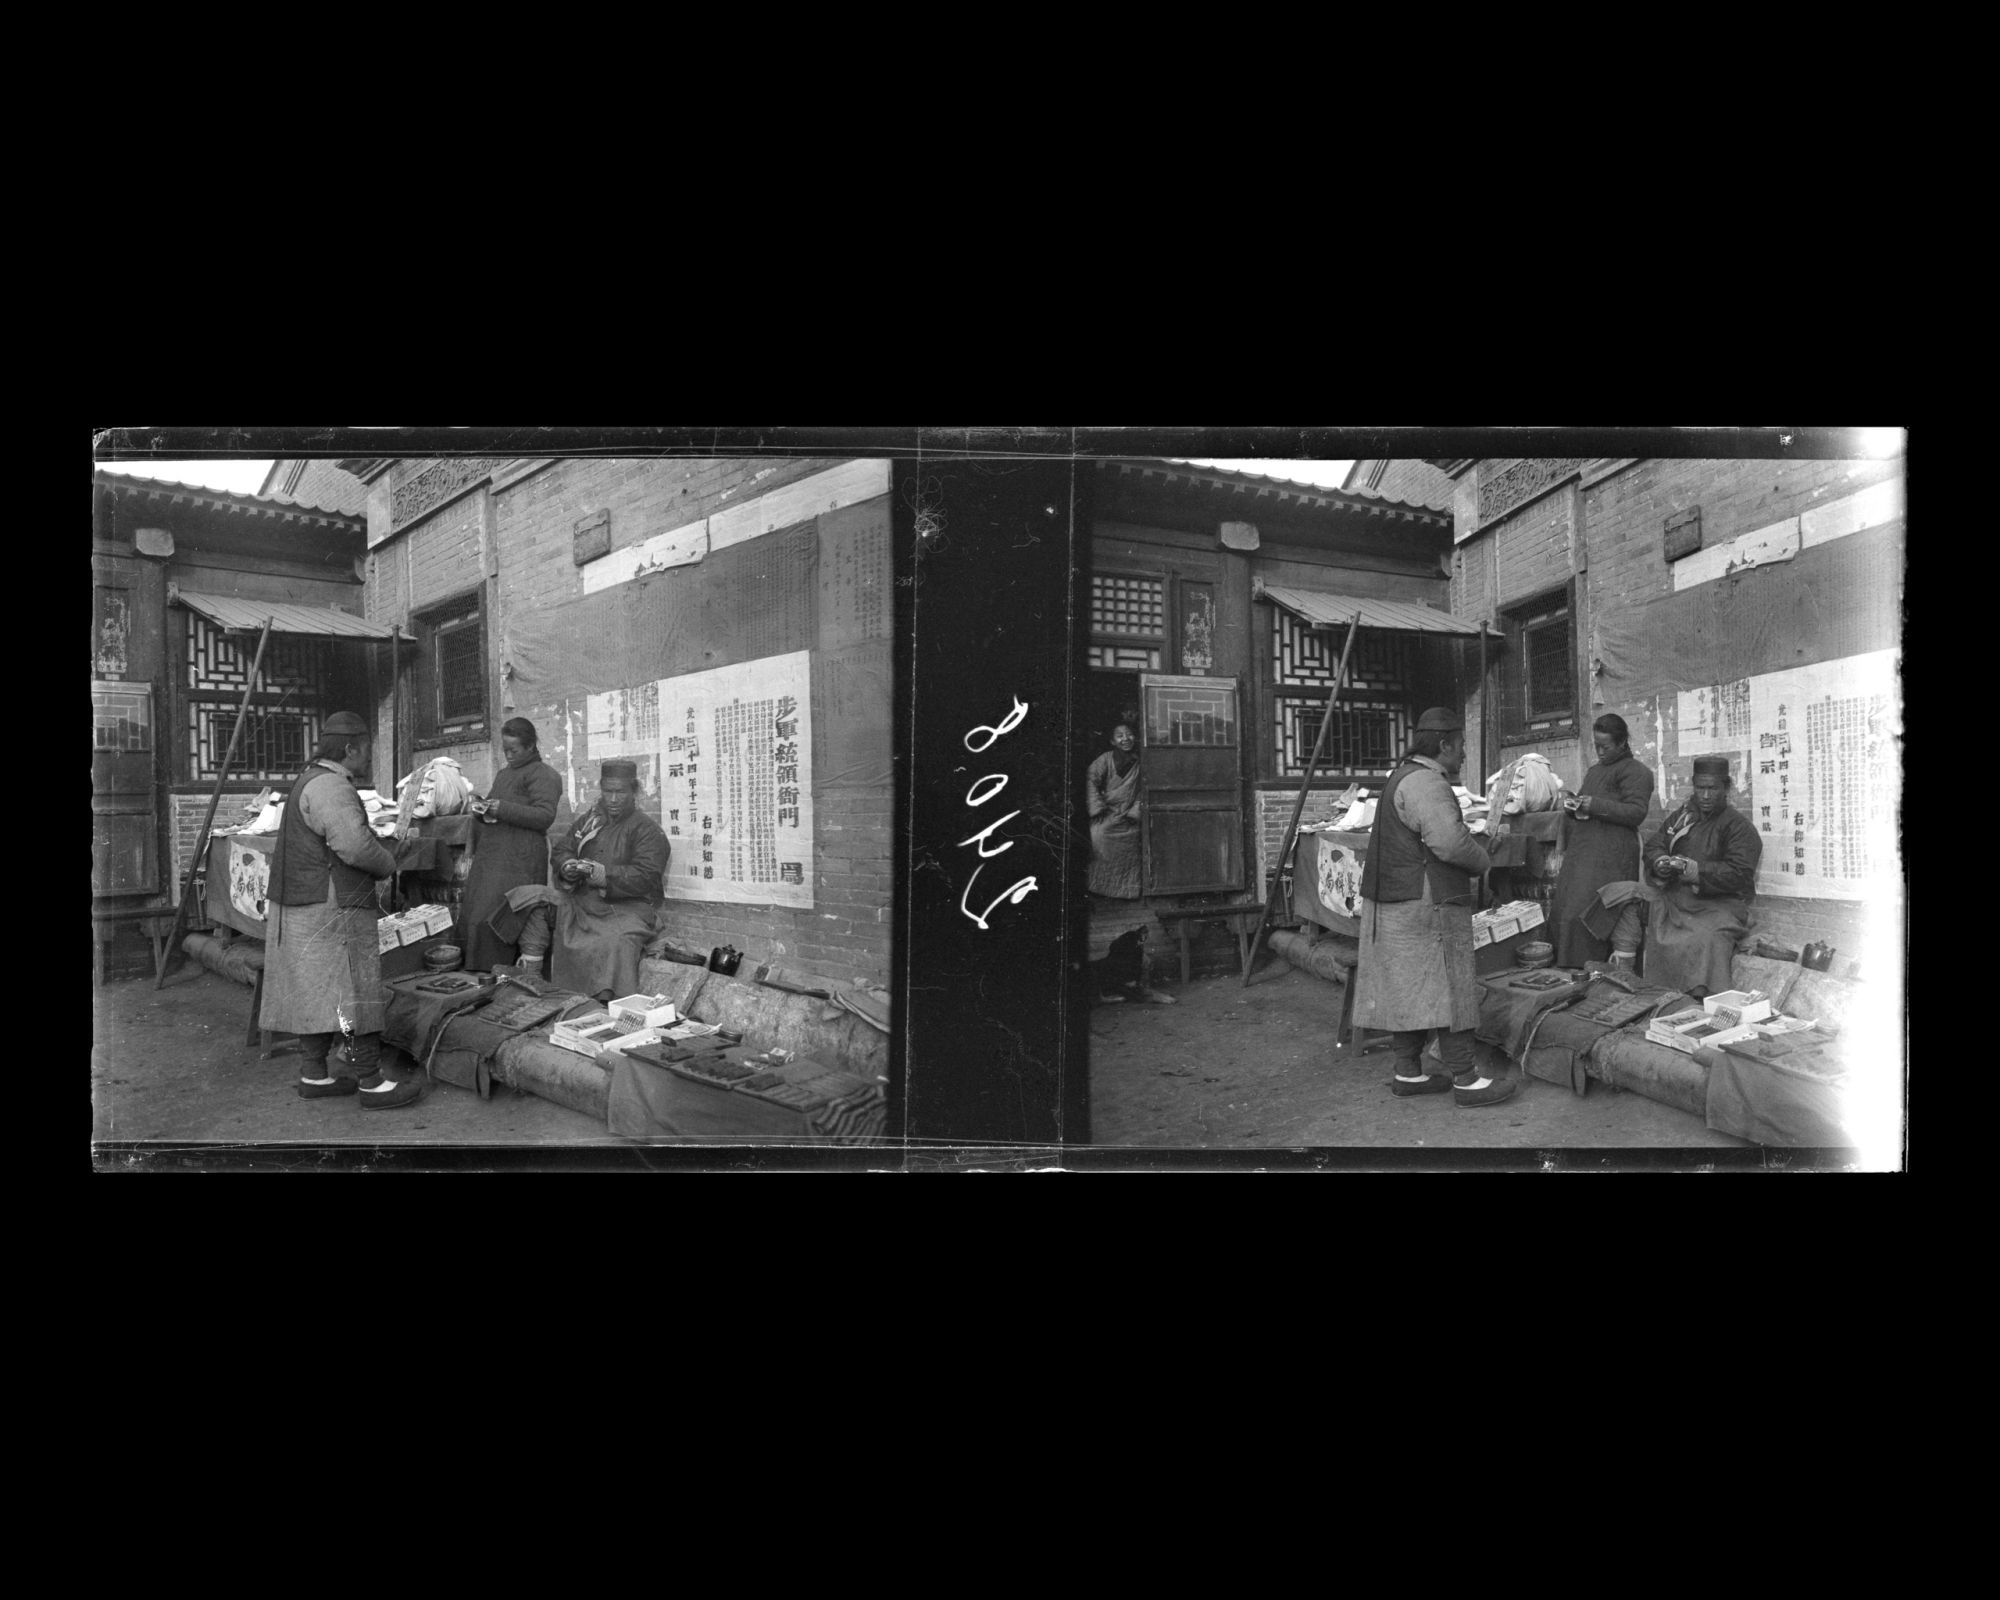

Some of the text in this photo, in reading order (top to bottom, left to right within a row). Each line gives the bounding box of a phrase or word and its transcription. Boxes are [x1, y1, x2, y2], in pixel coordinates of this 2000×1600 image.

[668, 735, 685, 778] 告示
[775, 695, 801, 829] 步軍統領衙門
[1759, 732, 1776, 775] 告示
